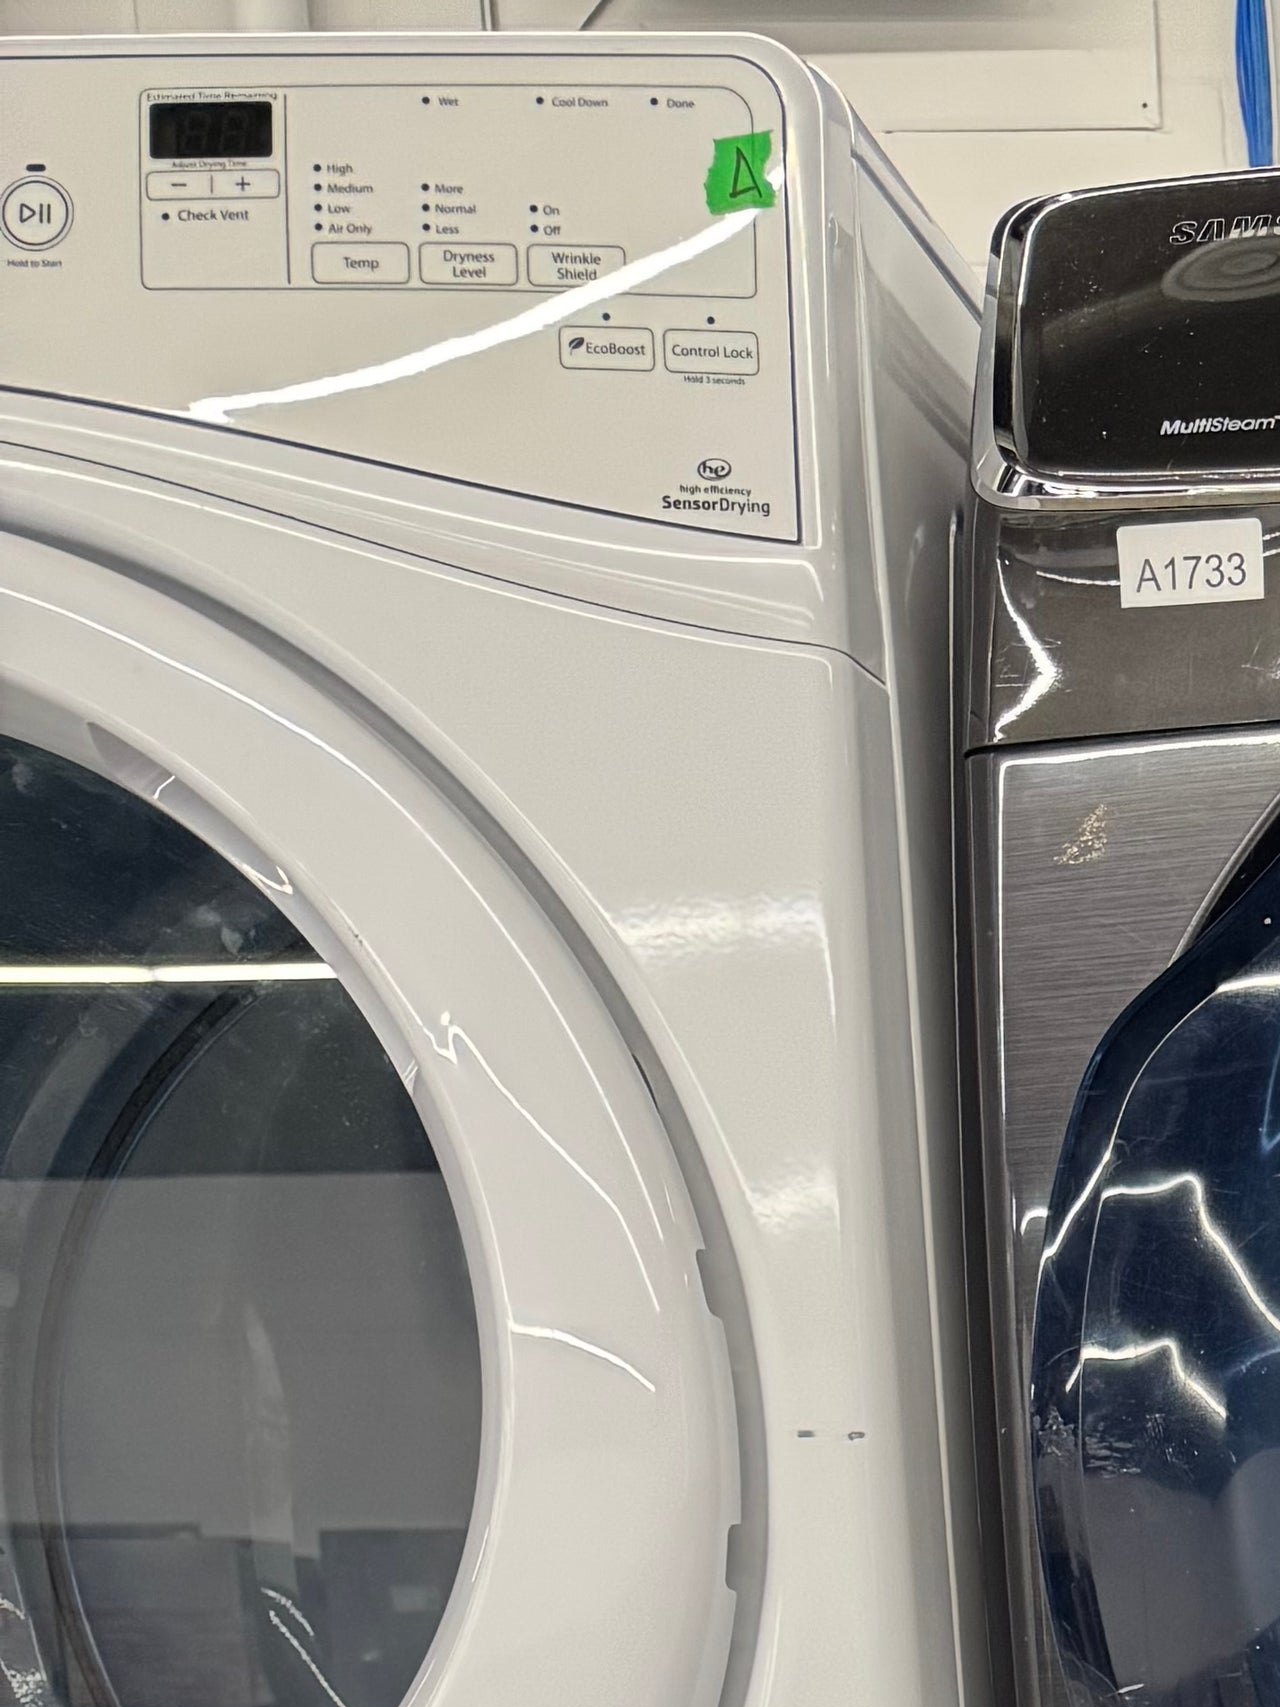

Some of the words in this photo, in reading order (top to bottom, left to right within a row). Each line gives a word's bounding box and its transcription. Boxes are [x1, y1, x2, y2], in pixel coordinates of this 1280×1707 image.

[439, 97, 458, 107] Wet
[667, 98, 694, 108] Done
[327, 163, 352, 174] High
[178, 209, 217, 221] Check
[221, 209, 249, 221] Vent
[343, 256, 379, 270] Temp
[443, 250, 495, 264] Dryness
[552, 252, 600, 266] Wrinkle
[453, 266, 486, 279] Level
[558, 267, 597, 281] Shield
[586, 343, 645, 355] EcoBoost
[672, 345, 719, 357] Control
[724, 347, 753, 359] Lock
[713, 377, 745, 385] seconds
[680, 485, 701, 494] high
[704, 486, 751, 497] efficiency
[662, 496, 770, 516] SensorDrying
[1137, 553, 1246, 592] A1733
